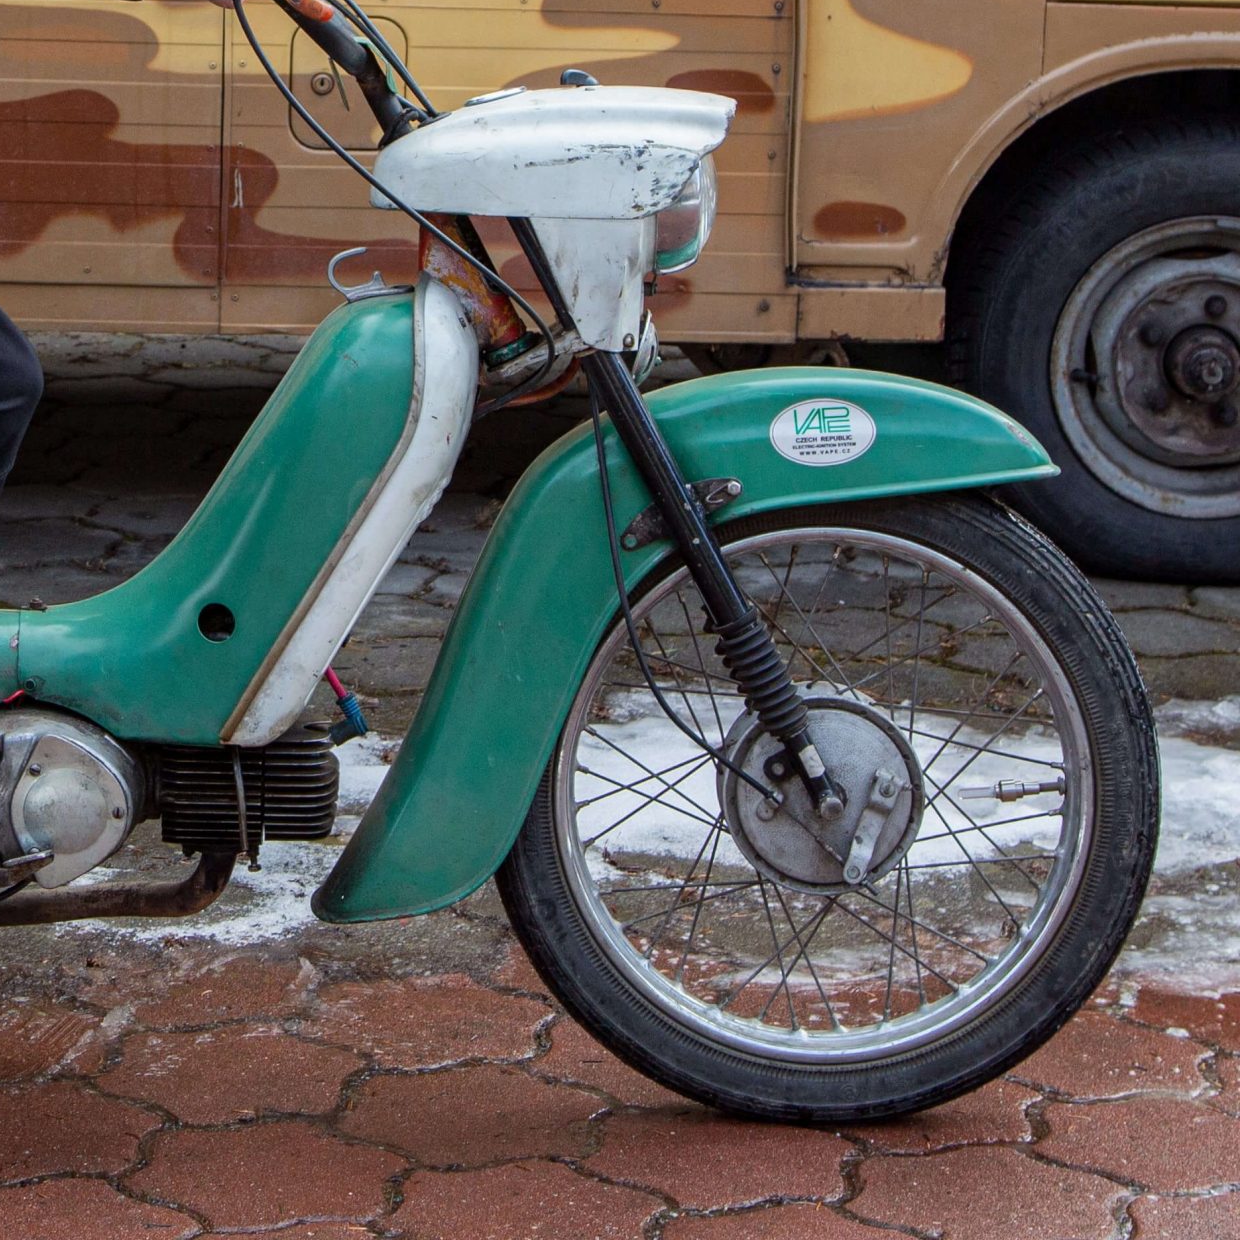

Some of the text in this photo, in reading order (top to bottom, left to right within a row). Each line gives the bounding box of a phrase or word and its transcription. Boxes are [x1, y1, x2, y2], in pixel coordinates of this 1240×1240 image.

[793, 406, 851, 435] VAPE
[795, 434, 853, 444] CZECH REPUBLIC
